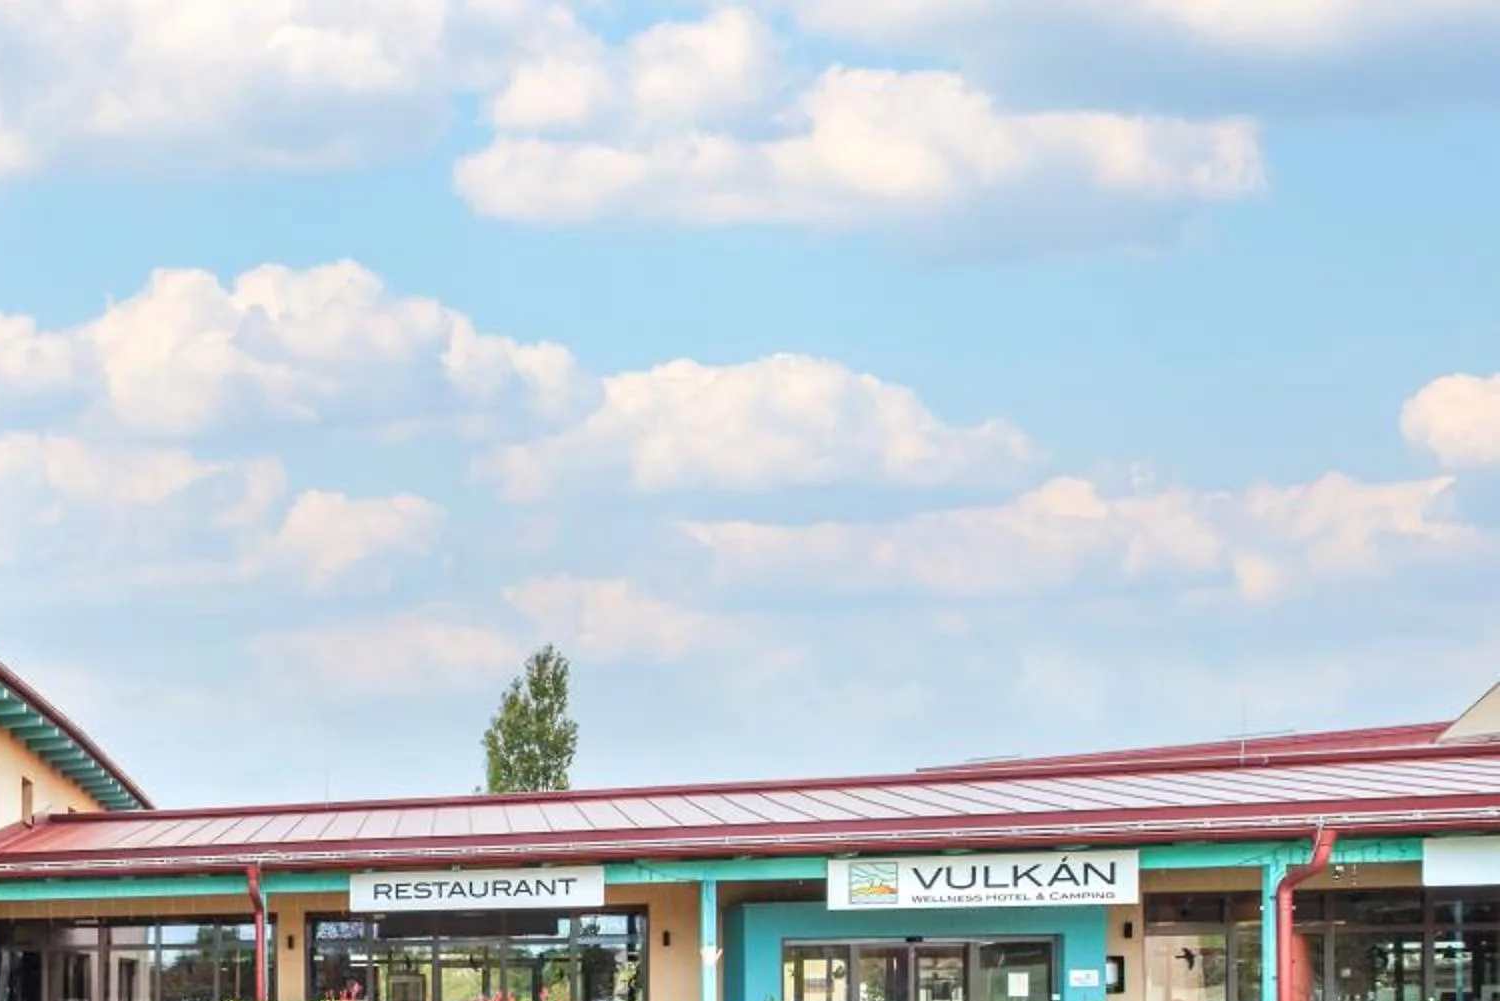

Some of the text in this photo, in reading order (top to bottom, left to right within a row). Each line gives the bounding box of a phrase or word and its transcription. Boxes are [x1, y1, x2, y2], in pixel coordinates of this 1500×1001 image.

[912, 856, 1117, 890] VULKÁN
[373, 877, 578, 901] RESTAURANT
[911, 894, 983, 904] WELLNESS
[986, 892, 1031, 902] HOTEL
[1049, 891, 1116, 901] CAMPING
